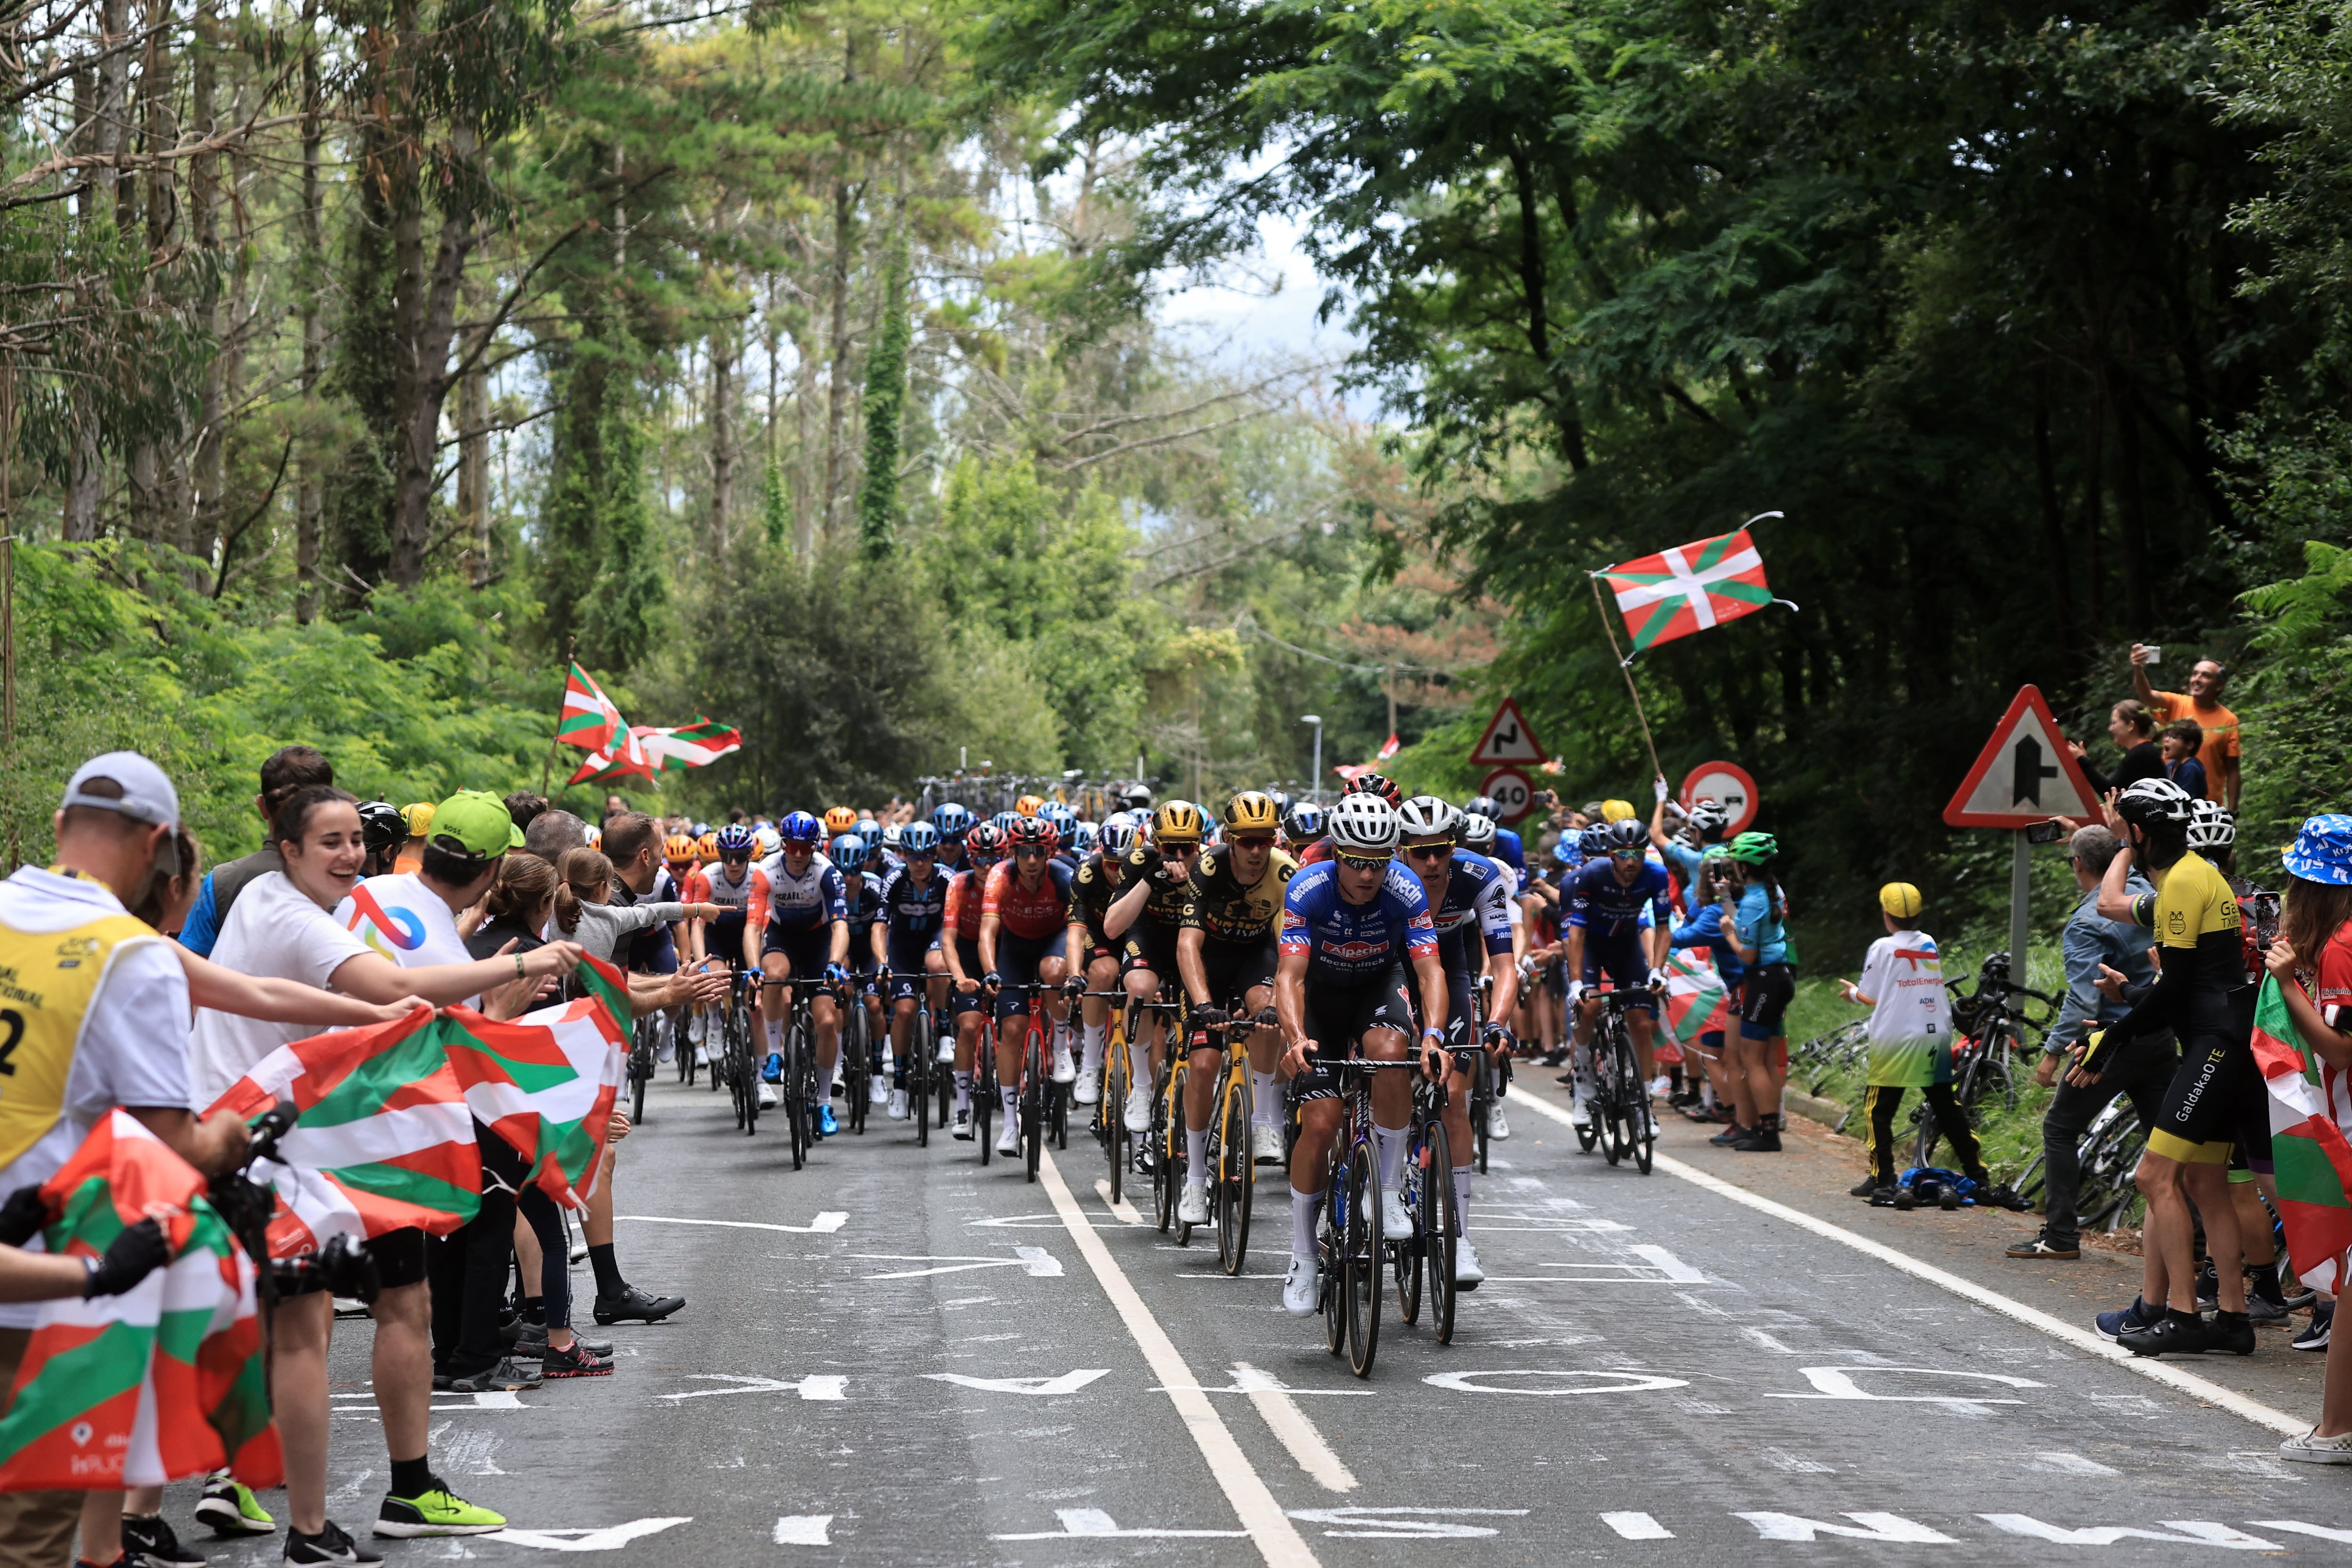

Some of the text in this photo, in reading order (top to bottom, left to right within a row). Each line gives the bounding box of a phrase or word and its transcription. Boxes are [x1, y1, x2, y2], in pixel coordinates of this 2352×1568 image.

[1493, 786, 1525, 804] 40
[443, 824, 462, 835] BOSS
[880, 870, 903, 903] youfone
[1289, 870, 1330, 902] deceuninck
[1383, 868, 1422, 905] Alpecin
[775, 891, 799, 900] ISRAEL
[1330, 947, 1382, 957] Alpecin
